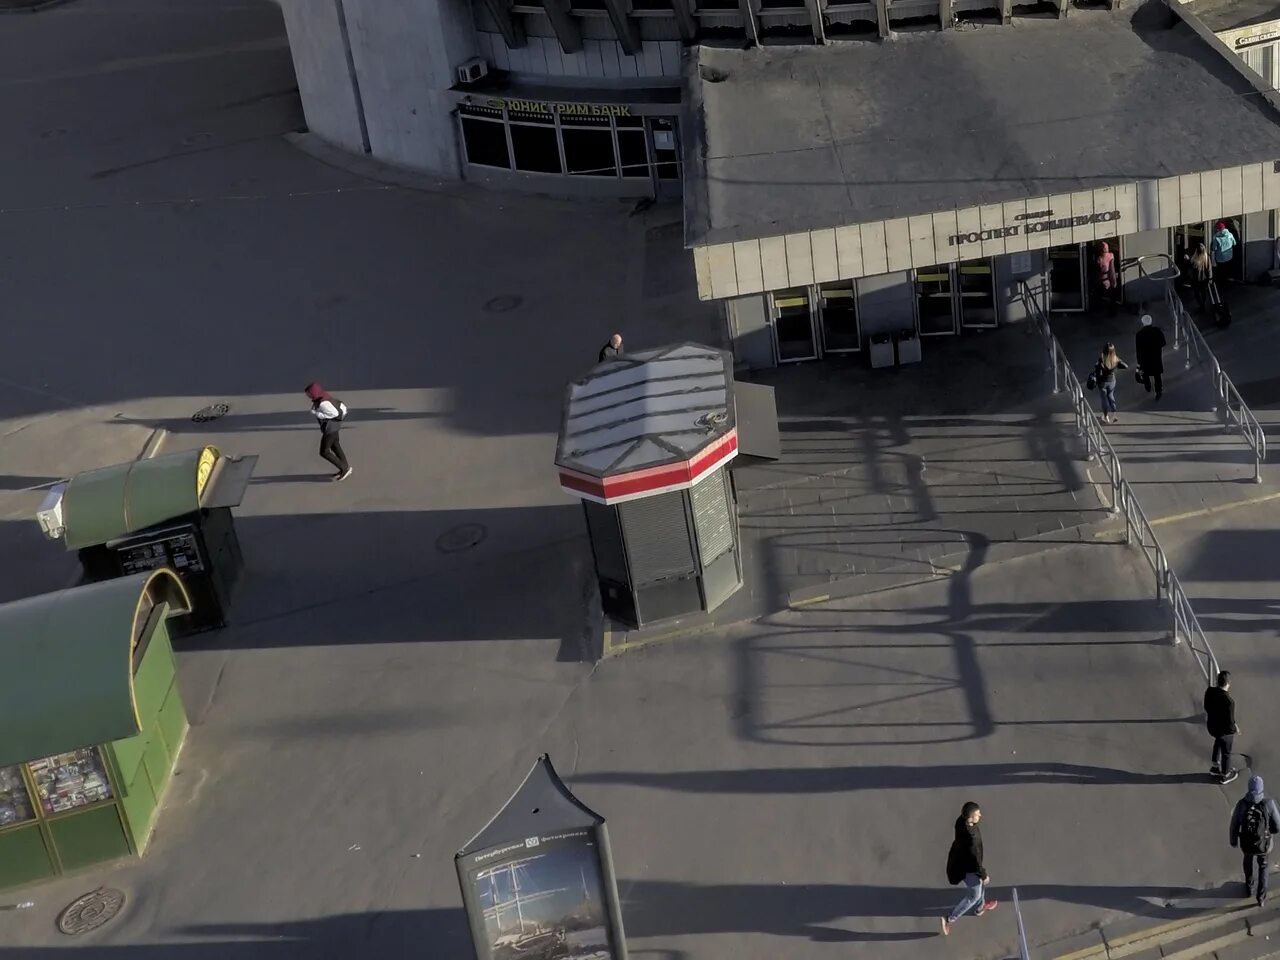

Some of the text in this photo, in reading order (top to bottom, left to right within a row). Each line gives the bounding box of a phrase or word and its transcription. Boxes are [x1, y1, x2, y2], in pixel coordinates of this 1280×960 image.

[591, 105, 632, 117] БАНК
[948, 210, 1121, 246] ПРОСПЕКТ БОЛЬШЕВИКОВ
